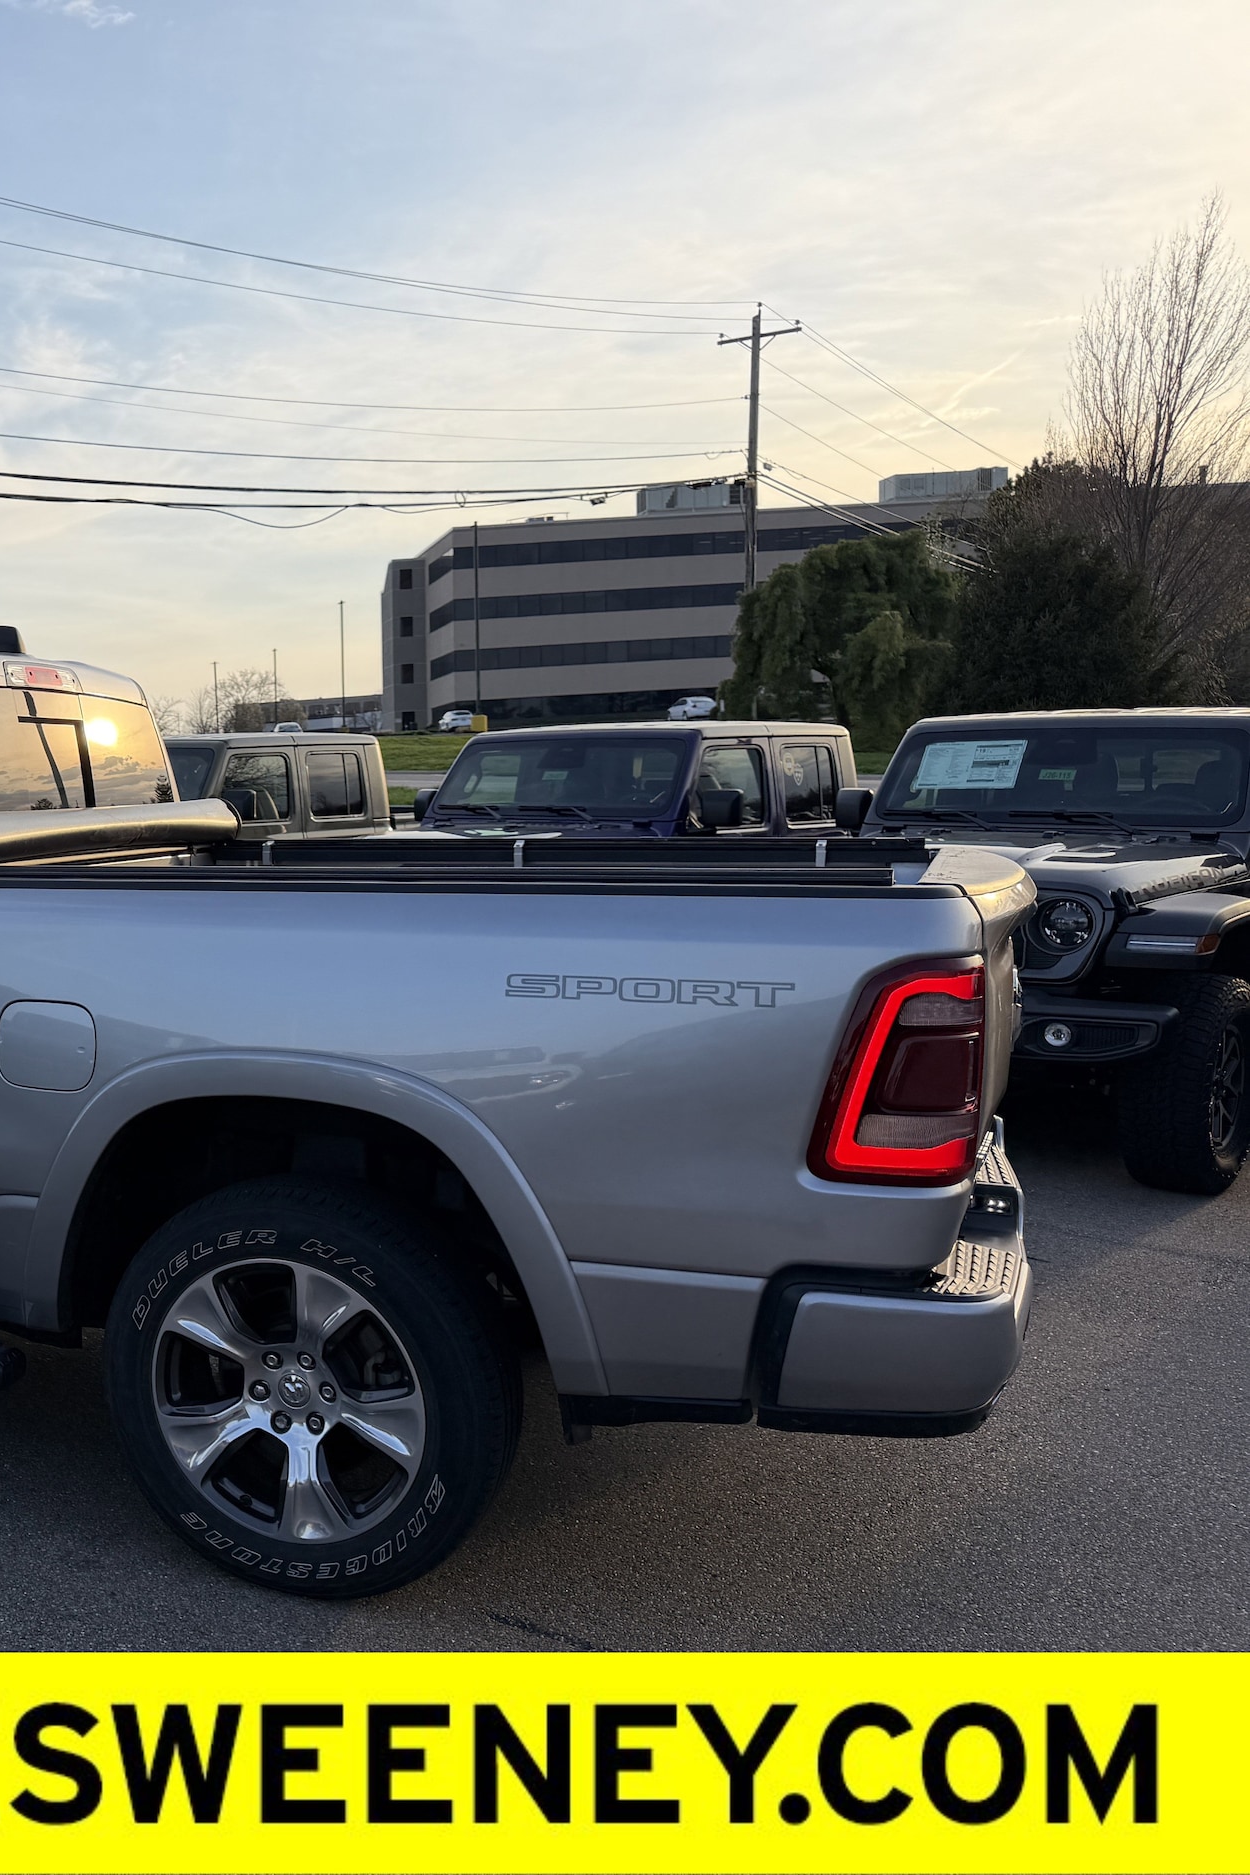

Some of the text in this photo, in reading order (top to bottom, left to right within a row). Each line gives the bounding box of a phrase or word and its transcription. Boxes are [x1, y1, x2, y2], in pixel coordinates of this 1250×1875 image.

[1136, 865, 1225, 896] RUBICON
[505, 973, 796, 1008] SPORT
[132, 1229, 377, 1331] DUELER H/L
[179, 1474, 447, 1580] BRIDGESTONE
